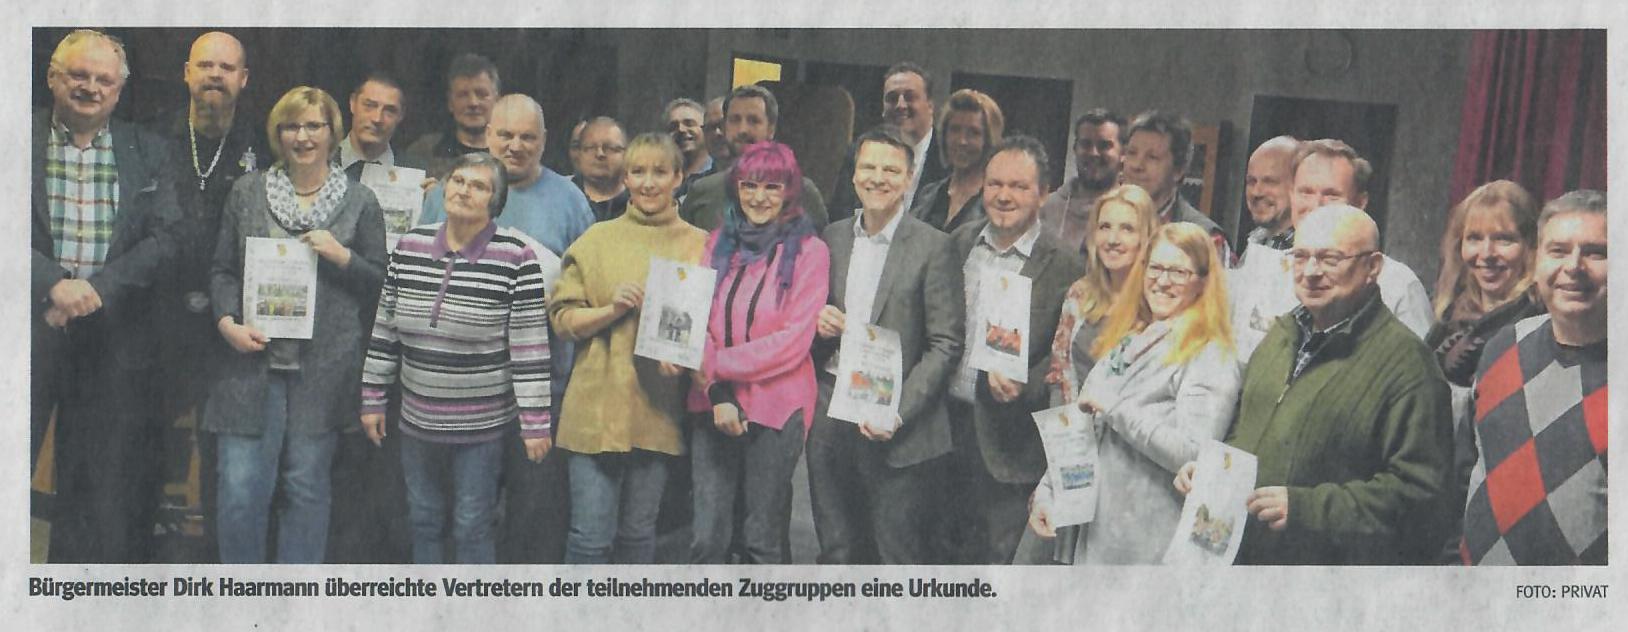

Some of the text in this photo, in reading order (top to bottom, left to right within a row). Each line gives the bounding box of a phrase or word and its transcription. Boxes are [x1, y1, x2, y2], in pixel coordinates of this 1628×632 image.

[29, 576, 997, 602] Bürgermeister Dirk Haarmann überreichte Vertretern der teilnehmenden Zuggruppen eine Urkunde.
[1516, 585, 1609, 598] FOTO: PRIVAT
